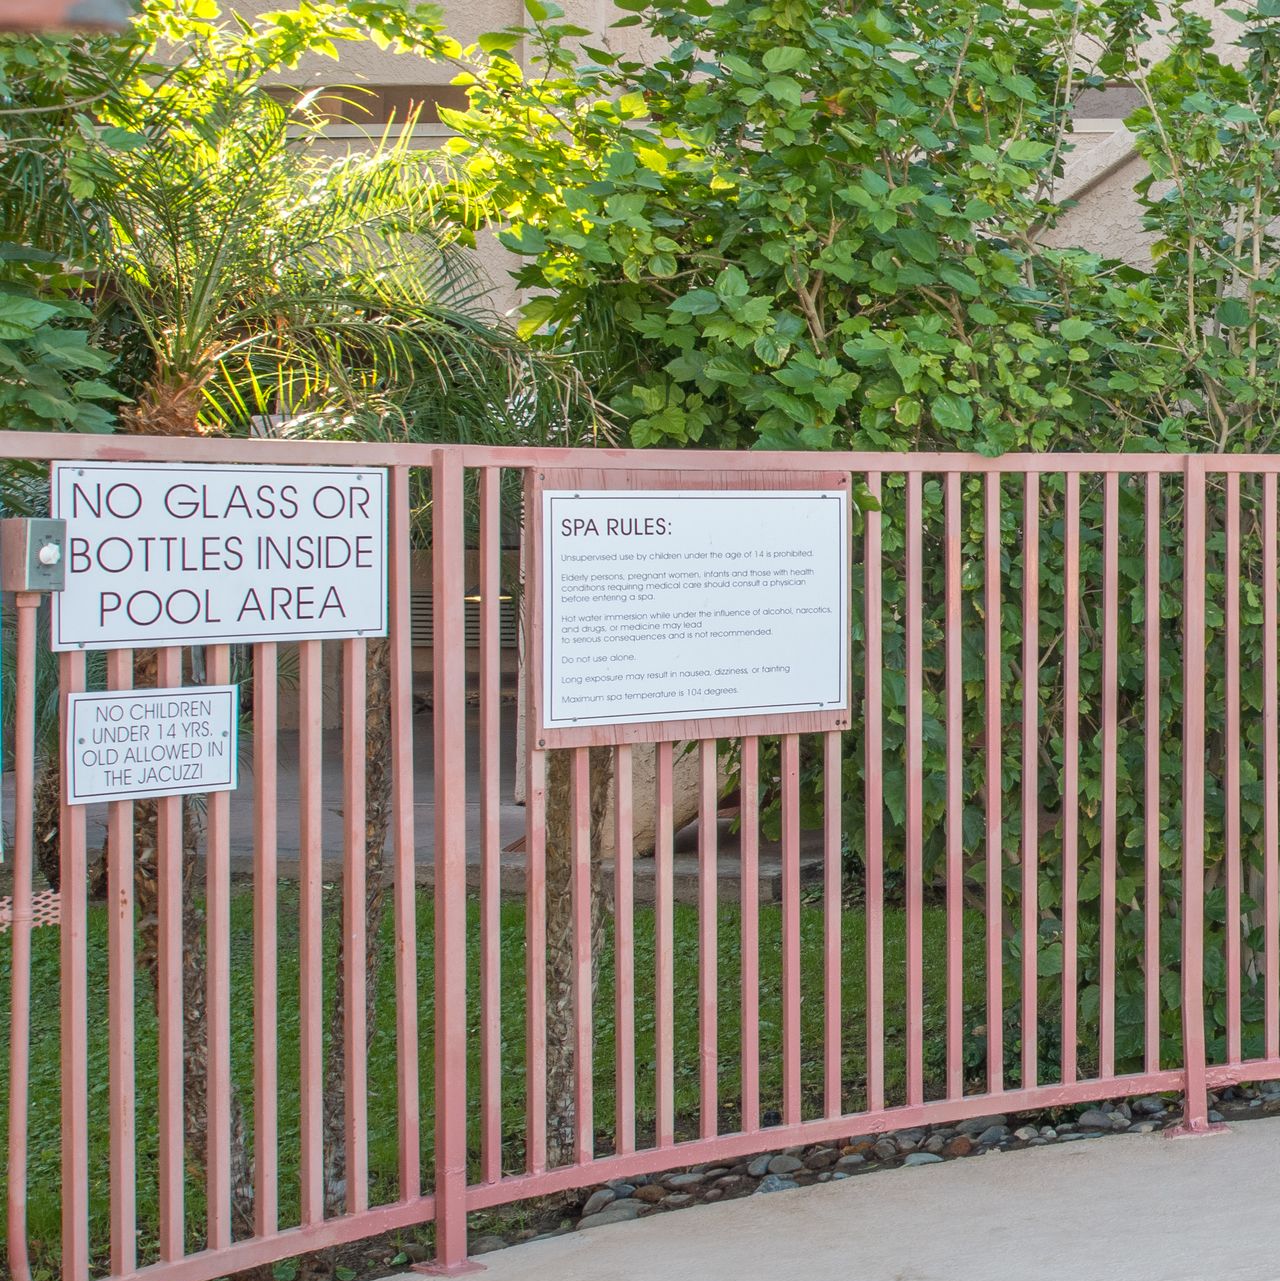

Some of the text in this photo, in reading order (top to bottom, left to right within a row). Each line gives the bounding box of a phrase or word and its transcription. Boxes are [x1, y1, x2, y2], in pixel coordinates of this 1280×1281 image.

[71, 482, 371, 520] NO GLASS OR
[560, 517, 673, 537] SPA RULES:
[70, 535, 373, 573] BOTTLES INSIDE
[560, 553, 617, 562] Unsupervised
[636, 553, 647, 561] by
[649, 552, 682, 560] children
[725, 552, 742, 560] age
[754, 550, 764, 558] 14
[766, 550, 772, 558] is
[773, 550, 814, 558] prohibited.
[561, 574, 589, 582] Elderly
[590, 574, 625, 582] persons,
[627, 571, 667, 581] pregnant
[703, 570, 730, 578] infants
[750, 569, 772, 577] those
[790, 568, 814, 576] health
[561, 583, 606, 593] conditions
[607, 583, 644, 592] requiring
[645, 582, 681, 590] medical
[682, 581, 702, 589] care
[704, 580, 730, 588] should
[732, 579, 761, 587] consult
[770, 578, 806, 587] physician
[99, 585, 346, 627] POOL AREA
[561, 594, 590, 603] before
[592, 593, 627, 603] entering
[637, 593, 656, 601] spa.
[561, 615, 576, 623] Hot
[578, 614, 602, 622] water
[604, 612, 648, 621] immersion
[649, 612, 671, 620] while
[672, 610, 696, 618] under
[698, 609, 712, 617] the
[713, 608, 751, 617] influence
[752, 608, 761, 616] of
[561, 625, 579, 633] and
[620, 622, 660, 631] medicine
[662, 622, 682, 630] may
[683, 620, 702, 628] lead
[561, 636, 570, 644] to
[572, 635, 602, 644] serious
[603, 633, 666, 643] consequences
[668, 631, 685, 639] and
[687, 631, 693, 639] is
[710, 628, 773, 638] recommended.
[561, 654, 637, 664] Do not use alone.
[561, 676, 583, 685] Long
[584, 673, 624, 683] exposure
[625, 673, 645, 681] may
[647, 671, 668, 679] result
[670, 670, 677, 678] in
[751, 666, 760, 674] or
[761, 664, 791, 673] fainting
[561, 695, 604, 704] Maximum
[606, 693, 622, 702] spa
[624, 690, 677, 700] temperature
[687, 688, 702, 696] 104
[95, 700, 212, 723] NO CHILDREN
[92, 721, 213, 745] UNDER 14 YRS.
[82, 740, 223, 767] OLD ALLOWED IN
[103, 763, 203, 787] THE JACUZZI
